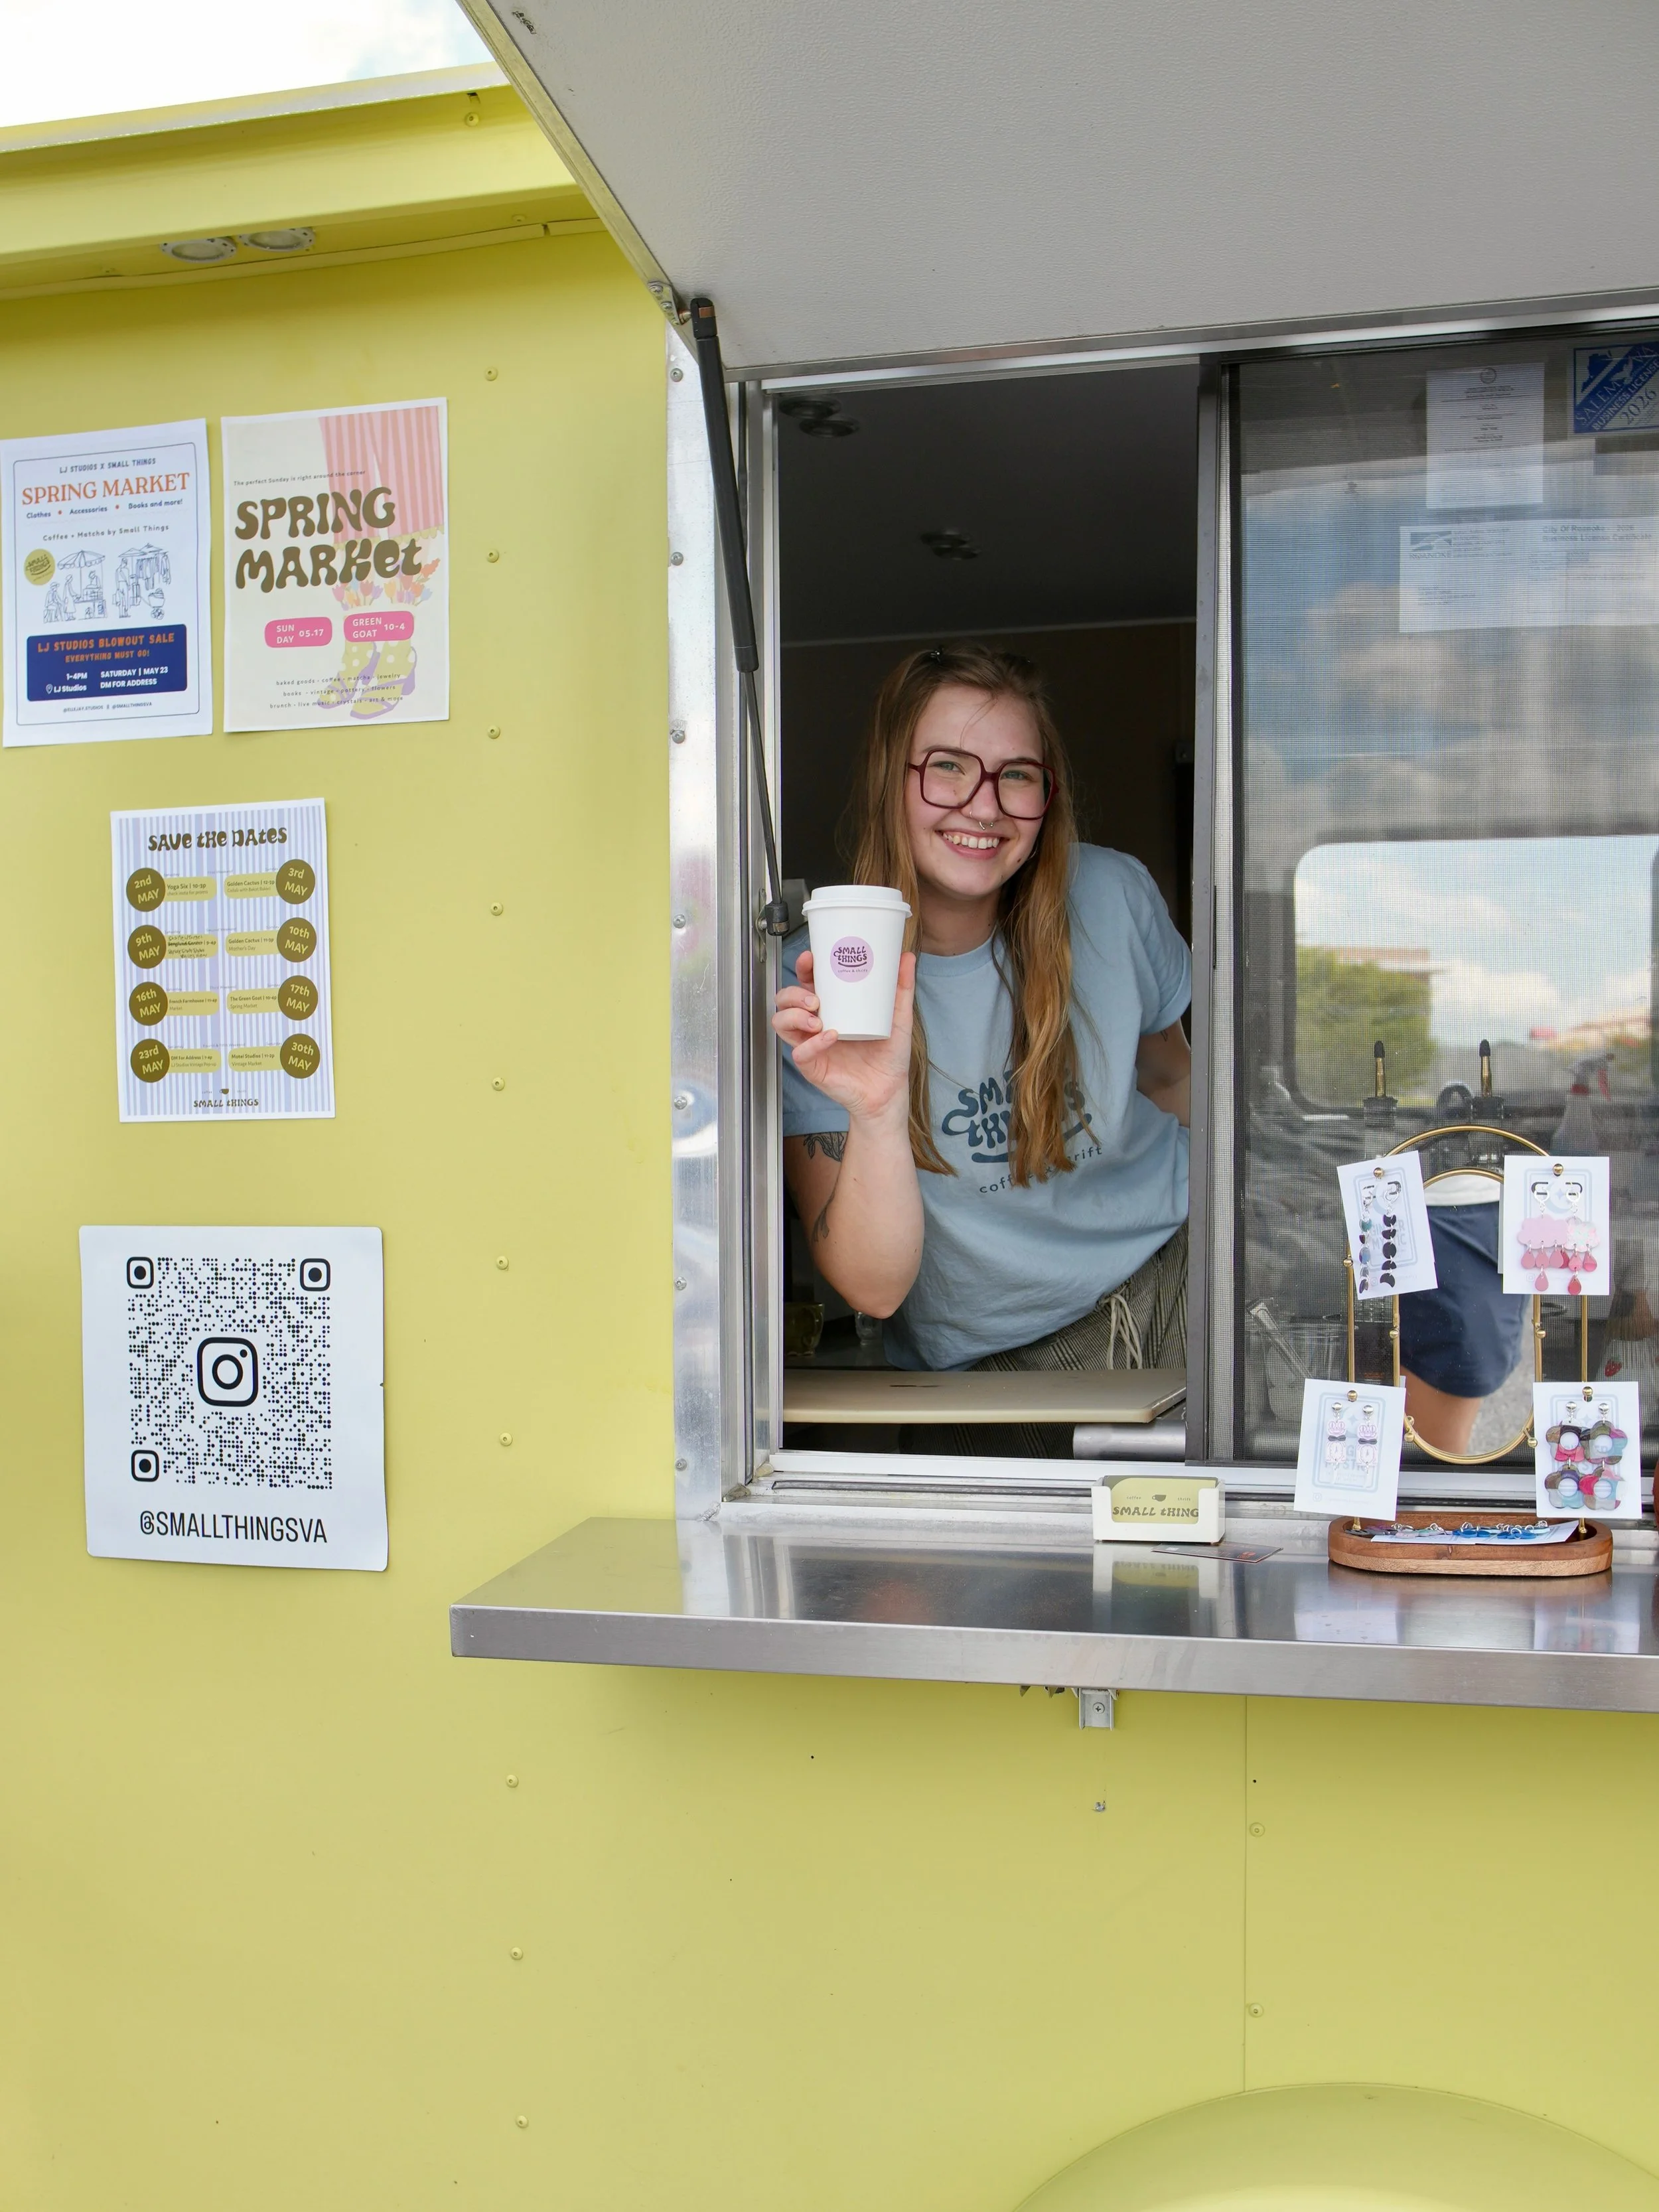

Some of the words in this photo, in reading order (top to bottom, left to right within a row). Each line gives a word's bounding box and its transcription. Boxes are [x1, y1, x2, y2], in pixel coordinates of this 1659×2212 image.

[1592, 392, 1630, 431] BUSINESS
[1628, 358, 1659, 393] LICENSE
[1576, 380, 1622, 425] SALEM
[1620, 388, 1656, 425] 2026
[70, 464, 97, 473] STUDIOS
[23, 482, 97, 505] SPRING
[103, 473, 190, 497] MARKET
[70, 506, 108, 515] Accessories
[235, 486, 395, 540] SPRING
[353, 618, 382, 627] GREEN
[38, 642, 49, 652] LJ
[54, 639, 94, 651] STUDIOS
[99, 635, 144, 648] BLOWOUT
[149, 633, 174, 644] SALE
[65, 652, 111, 663] EVERYTHING
[115, 650, 133, 659] MUST
[101, 669, 135, 678] SATURDAY
[127, 678, 157, 687] ADDRESS
[288, 867, 305, 879] 3rd
[135, 874, 152, 889] 2nd
[285, 881, 308, 896] MAY
[137, 889, 159, 905] MAY
[289, 925, 310, 938] 10th
[135, 934, 152, 946] 9th
[285, 939, 308, 954] MAY
[139, 946, 160, 961] MAY
[136, 989, 157, 1002] 16th
[290, 984, 310, 997] 17th
[139, 1003, 161, 1018] MAY
[286, 997, 310, 1013] MAY
[139, 1046, 159, 1059] 23rd
[291, 1042, 314, 1055] 30th
[142, 1060, 163, 1074] MAY
[288, 1056, 311, 1070] MAY
[1113, 1507, 1156, 1516] SMALL
[140, 1511, 327, 1542] @SMALLTHINGSVA
